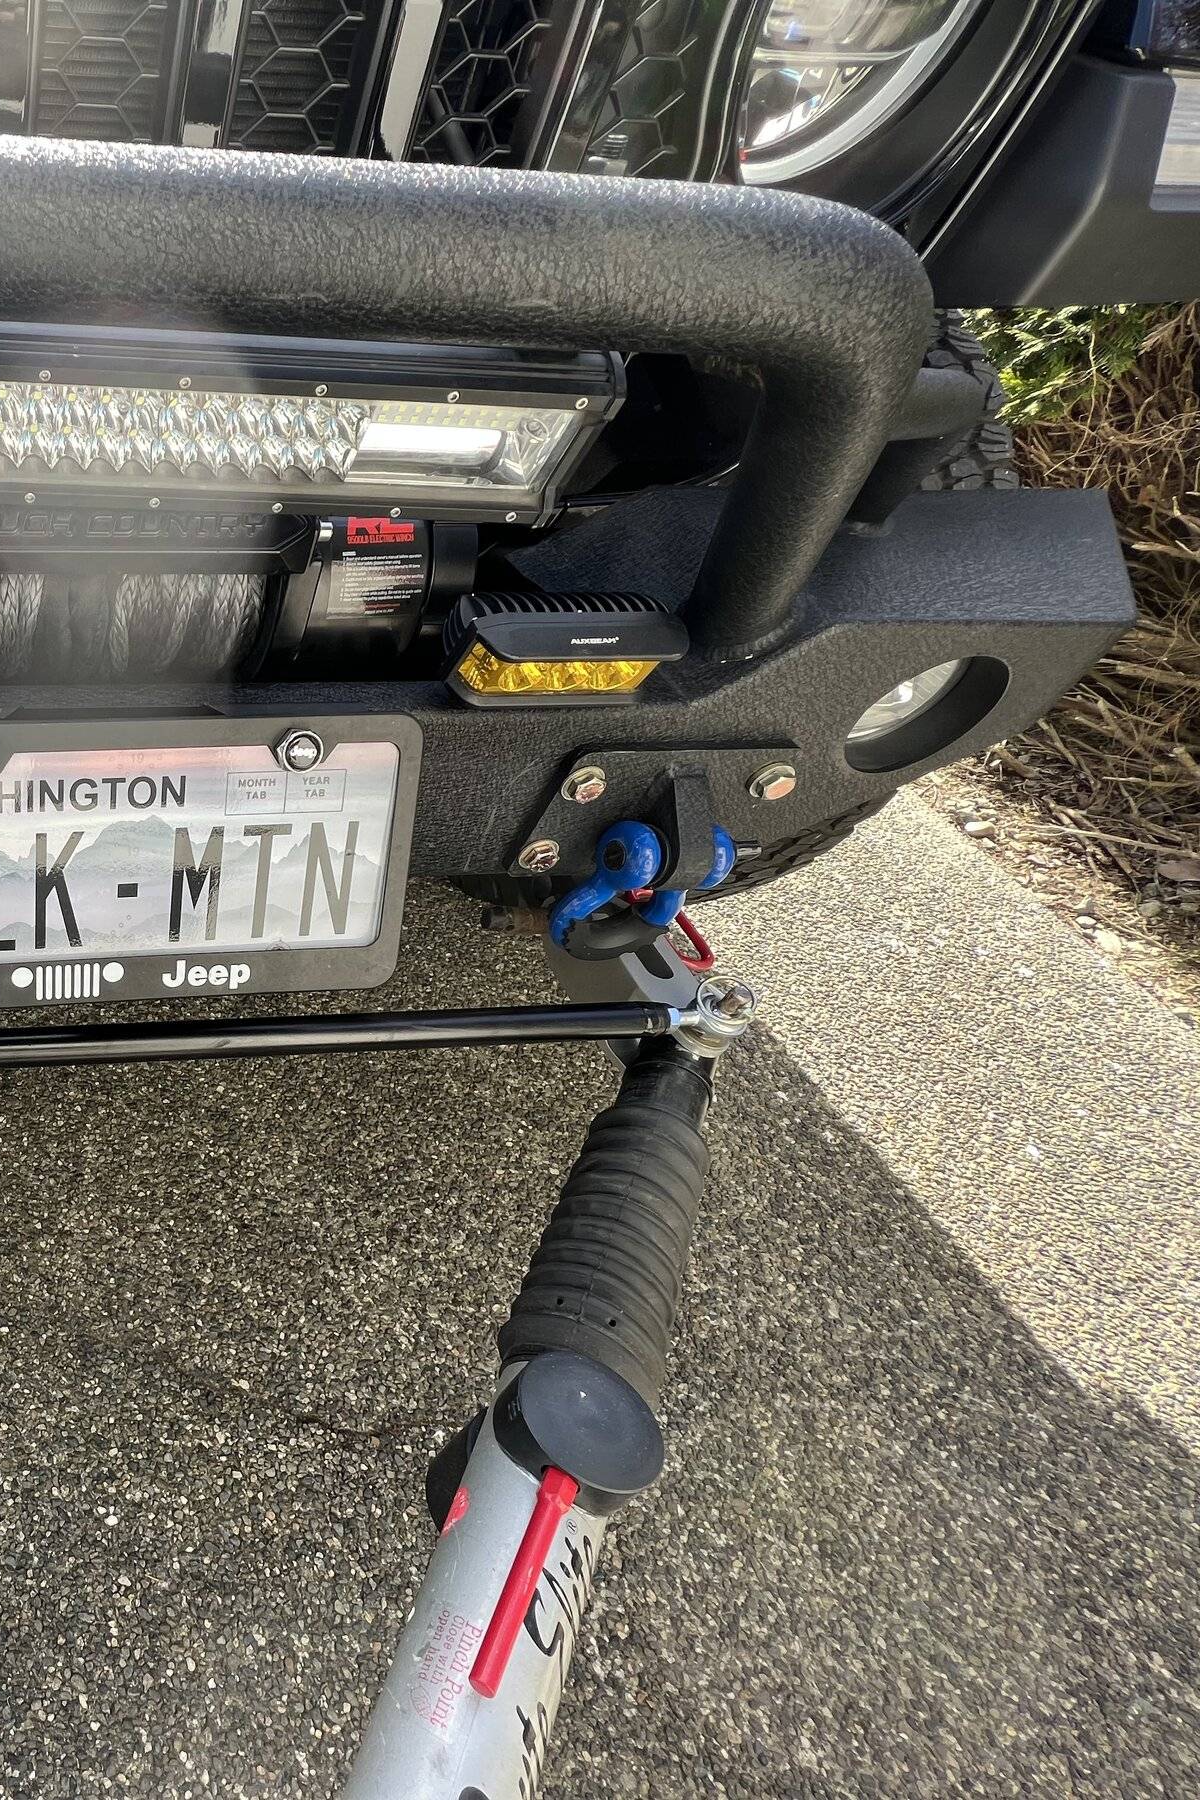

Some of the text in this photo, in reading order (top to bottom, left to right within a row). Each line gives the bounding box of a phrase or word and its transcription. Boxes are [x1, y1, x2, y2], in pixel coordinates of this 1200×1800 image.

[86, 513, 268, 538] COUNTRY
[238, 778, 277, 788] MONTH
[302, 776, 330, 786] YEAR
[304, 788, 326, 798] TAB
[246, 791, 267, 800] TAB
[162, 959, 252, 990] Jeep
[418, 1608, 451, 1681] open hand
[430, 1614, 466, 1685] Close with
[429, 1620, 484, 1729] Pinch Point
